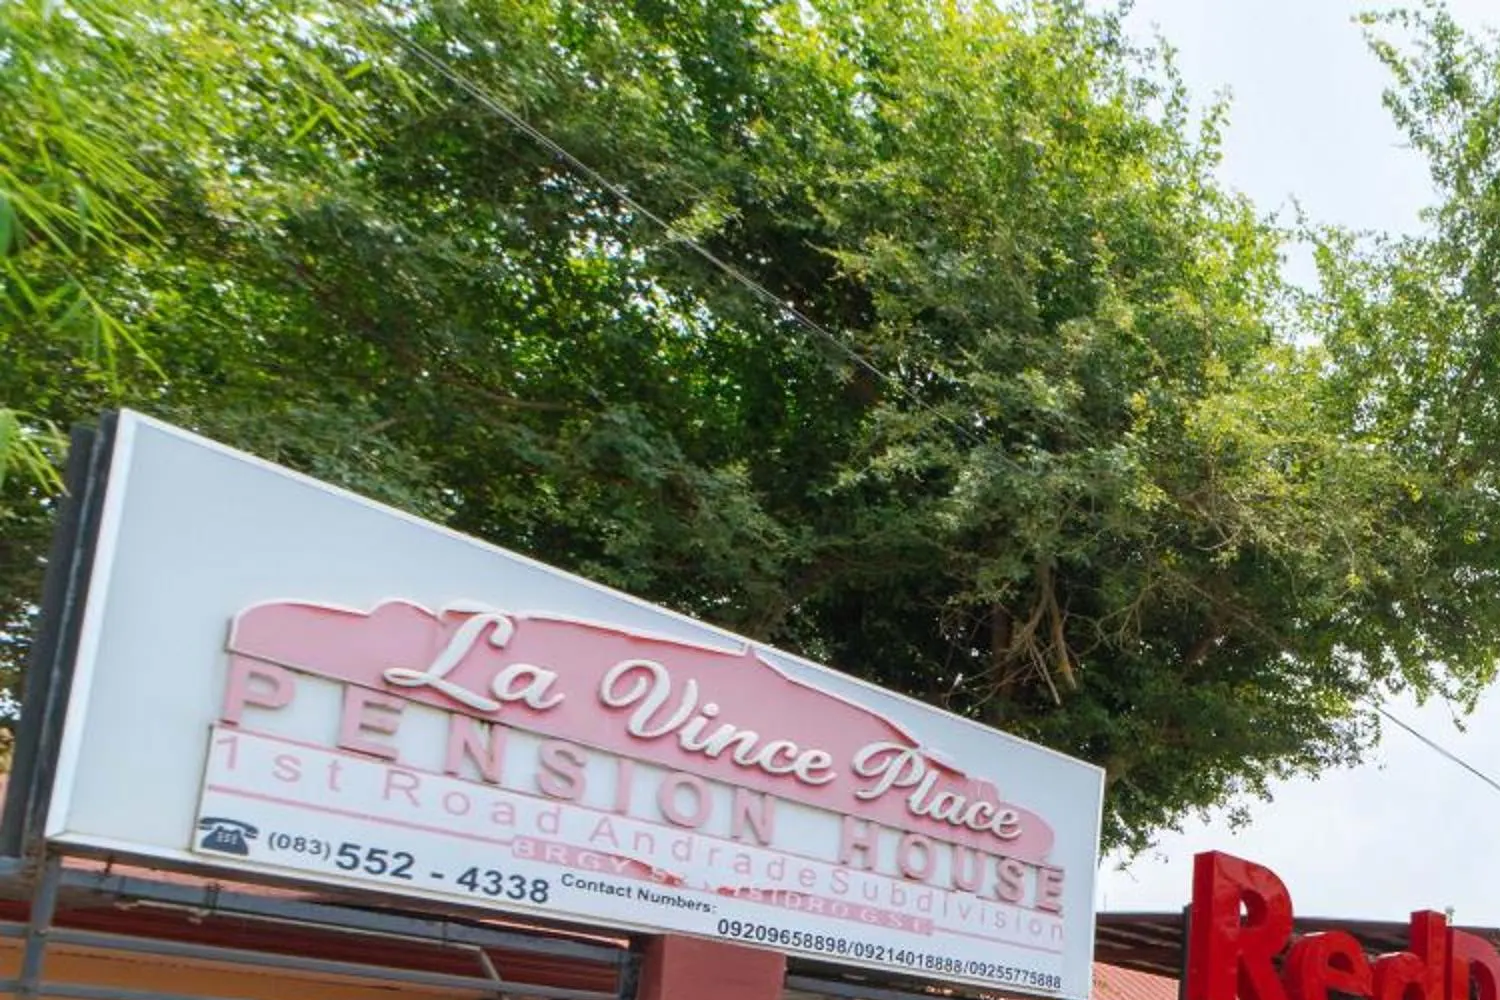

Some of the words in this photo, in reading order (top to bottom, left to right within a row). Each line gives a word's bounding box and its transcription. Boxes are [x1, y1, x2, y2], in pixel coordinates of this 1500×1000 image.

[383, 612, 565, 711] La
[601, 659, 837, 785] Vince
[852, 741, 1022, 839] Place
[215, 736, 342, 792] 1st
[383, 769, 561, 834] Road
[220, 653, 776, 845] PENSION
[839, 814, 1064, 916] HOUSE
[268, 831, 331, 860] (083)
[336, 842, 415, 880] 552
[456, 866, 549, 904] 4338
[513, 837, 632, 872] BRGY
[560, 873, 633, 898] Contact
[637, 889, 719, 914] Numbers:
